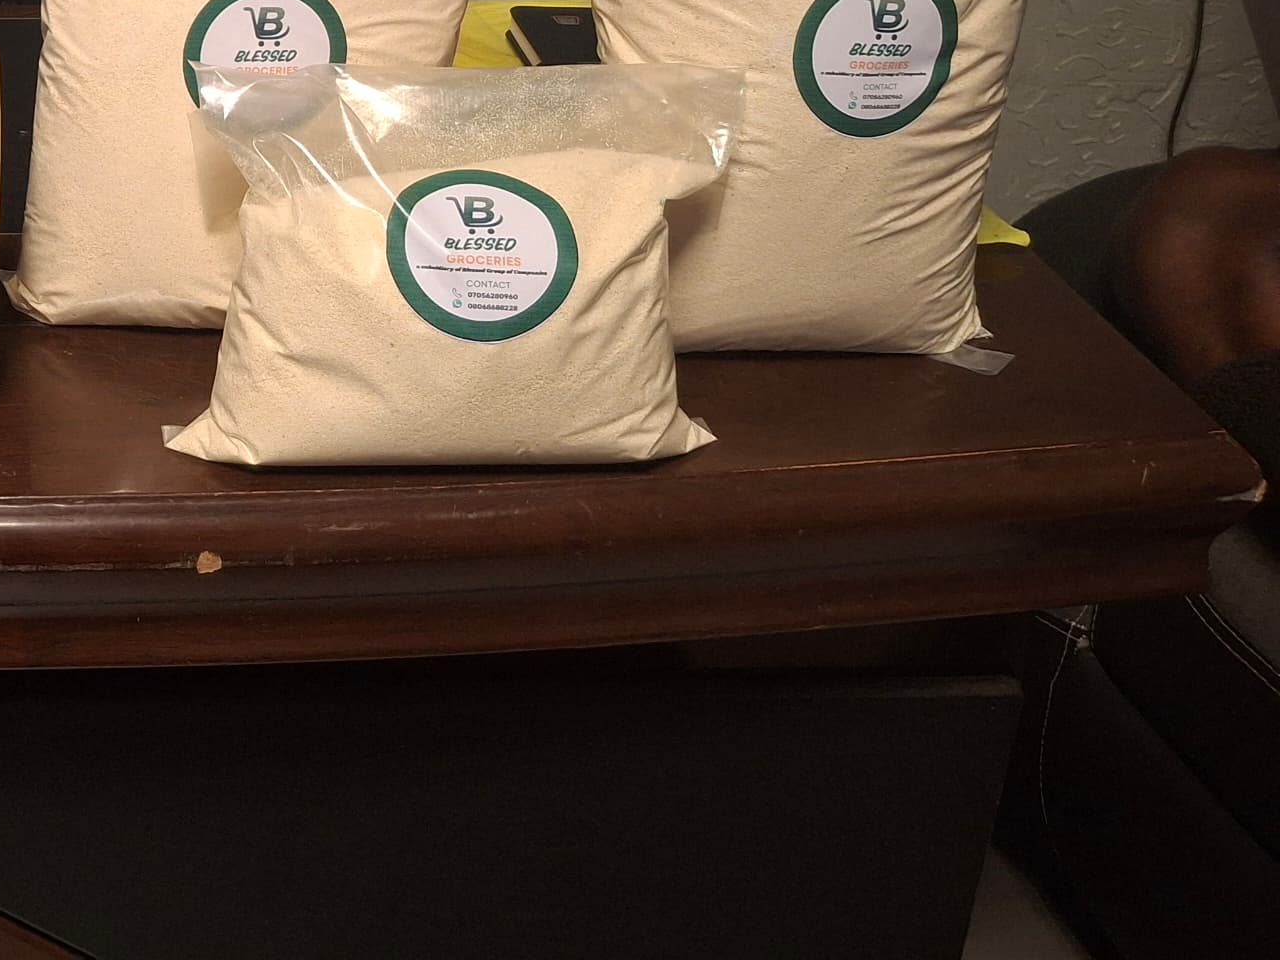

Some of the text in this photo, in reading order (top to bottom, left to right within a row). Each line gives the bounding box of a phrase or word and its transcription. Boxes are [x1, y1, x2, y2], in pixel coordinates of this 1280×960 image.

[234, 50, 297, 62] BLESSED
[849, 43, 912, 57] BLESSED
[849, 61, 910, 70] GROCERIES
[863, 83, 897, 91] CONTACT
[444, 238, 517, 251] BLESSED
[447, 254, 521, 267] GROCERIES
[466, 280, 511, 289] CONTACT
